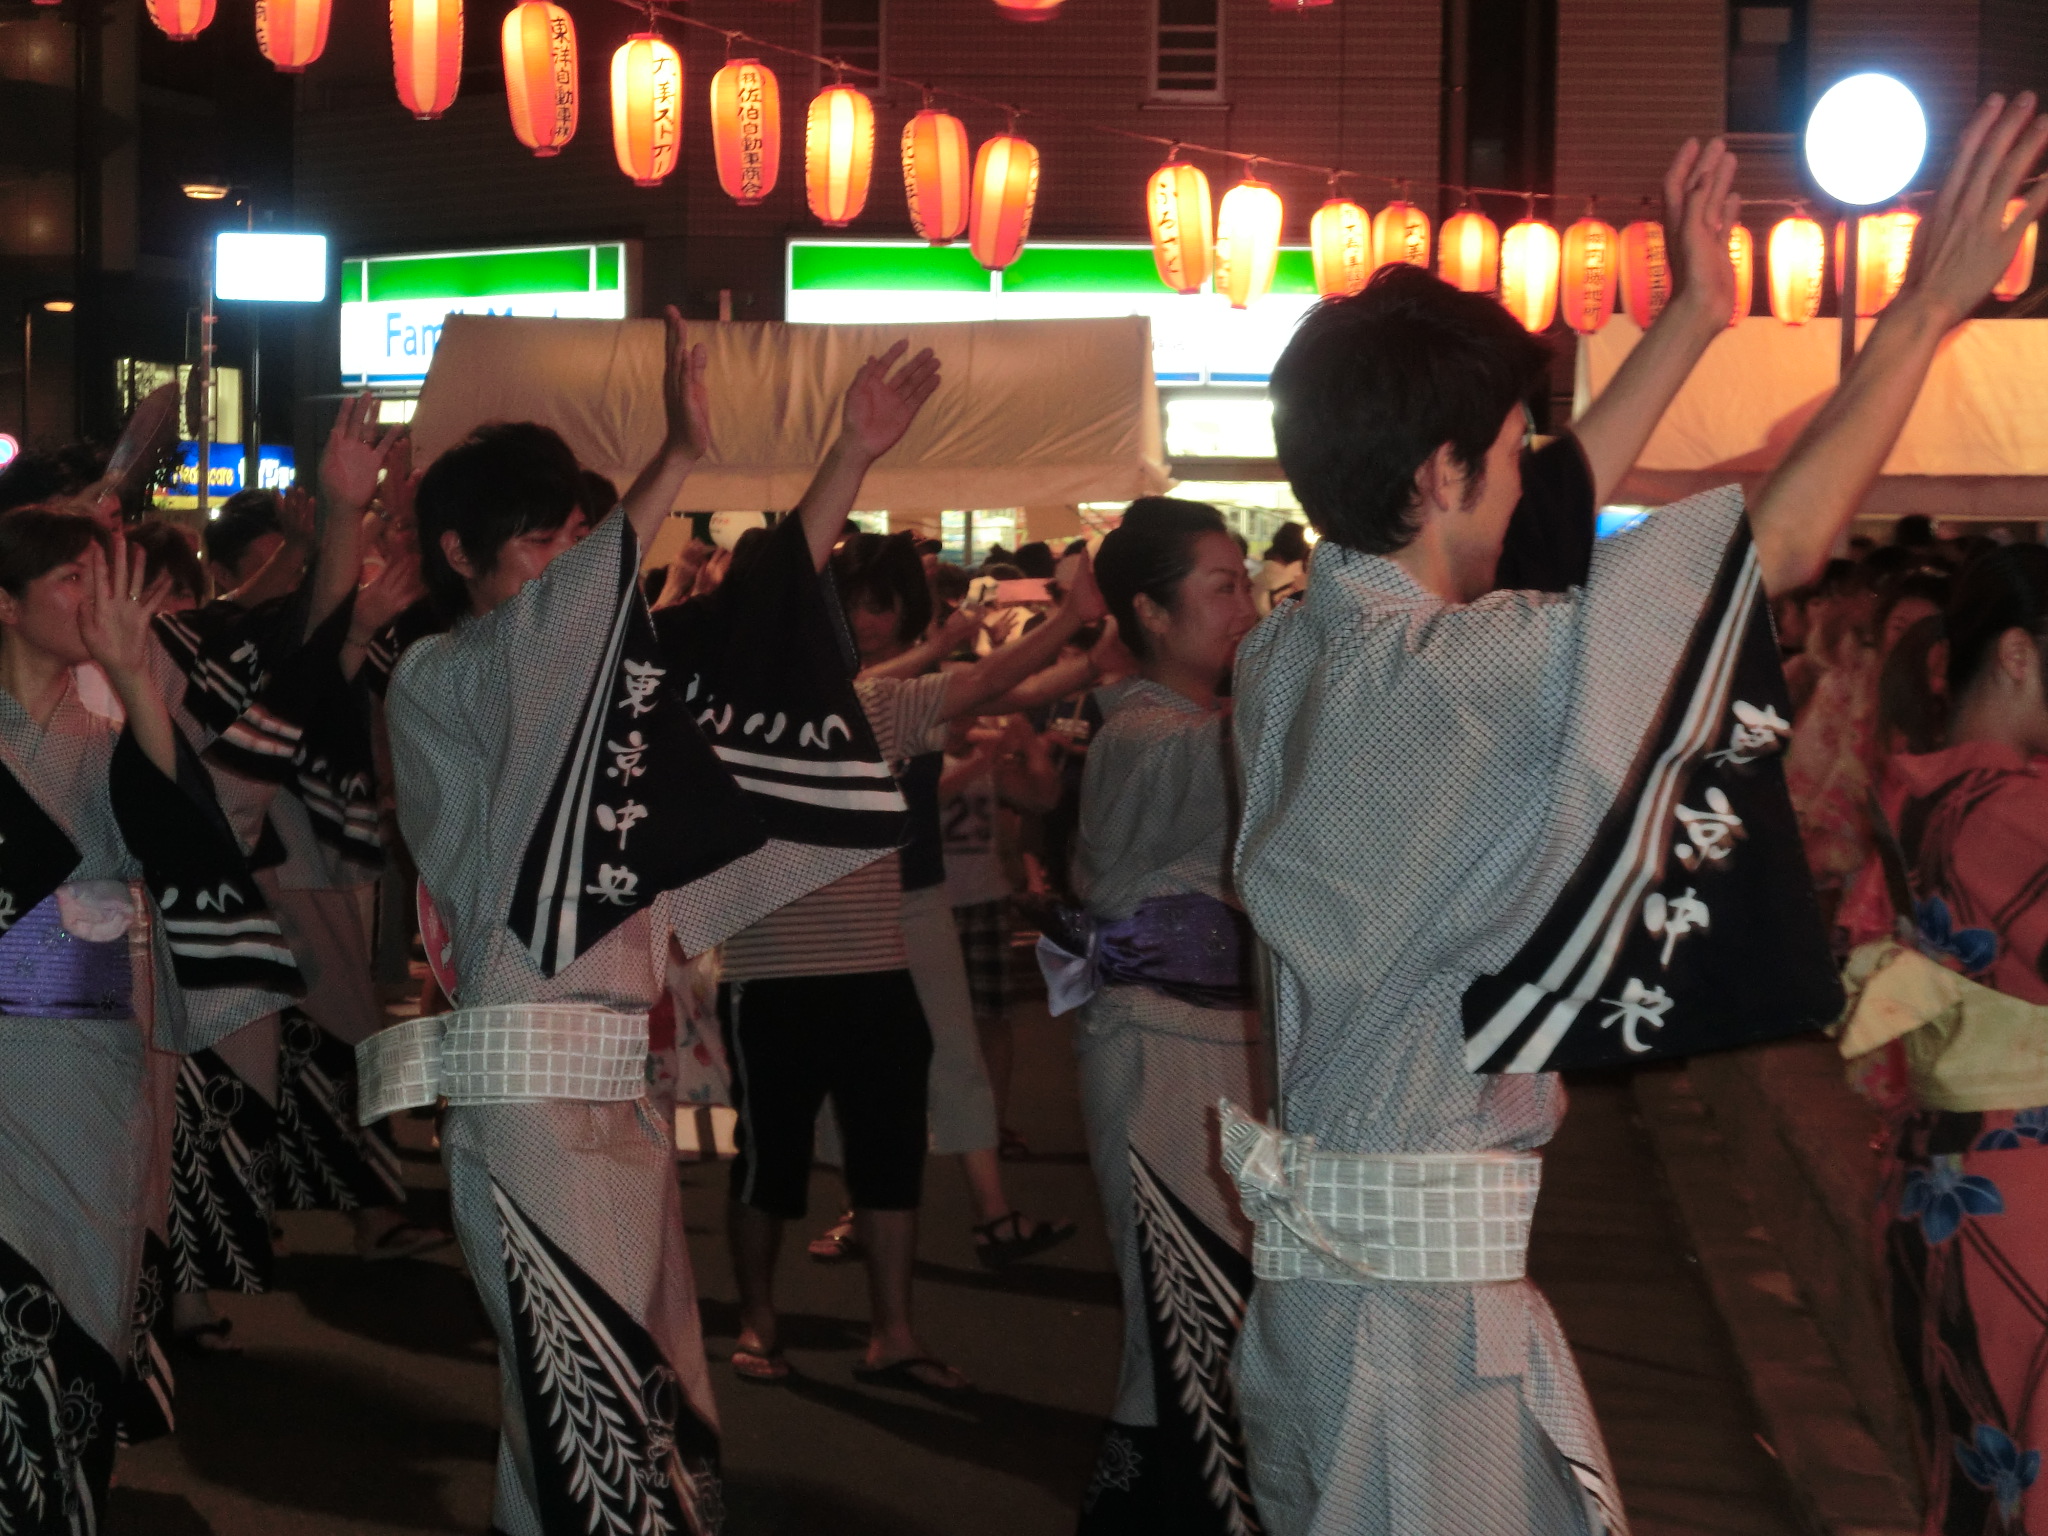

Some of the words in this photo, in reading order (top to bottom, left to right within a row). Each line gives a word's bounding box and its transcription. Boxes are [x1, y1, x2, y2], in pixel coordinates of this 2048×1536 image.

[586, 657, 667, 906] 東京中央
[1600, 699, 1791, 1052] 東京中央
